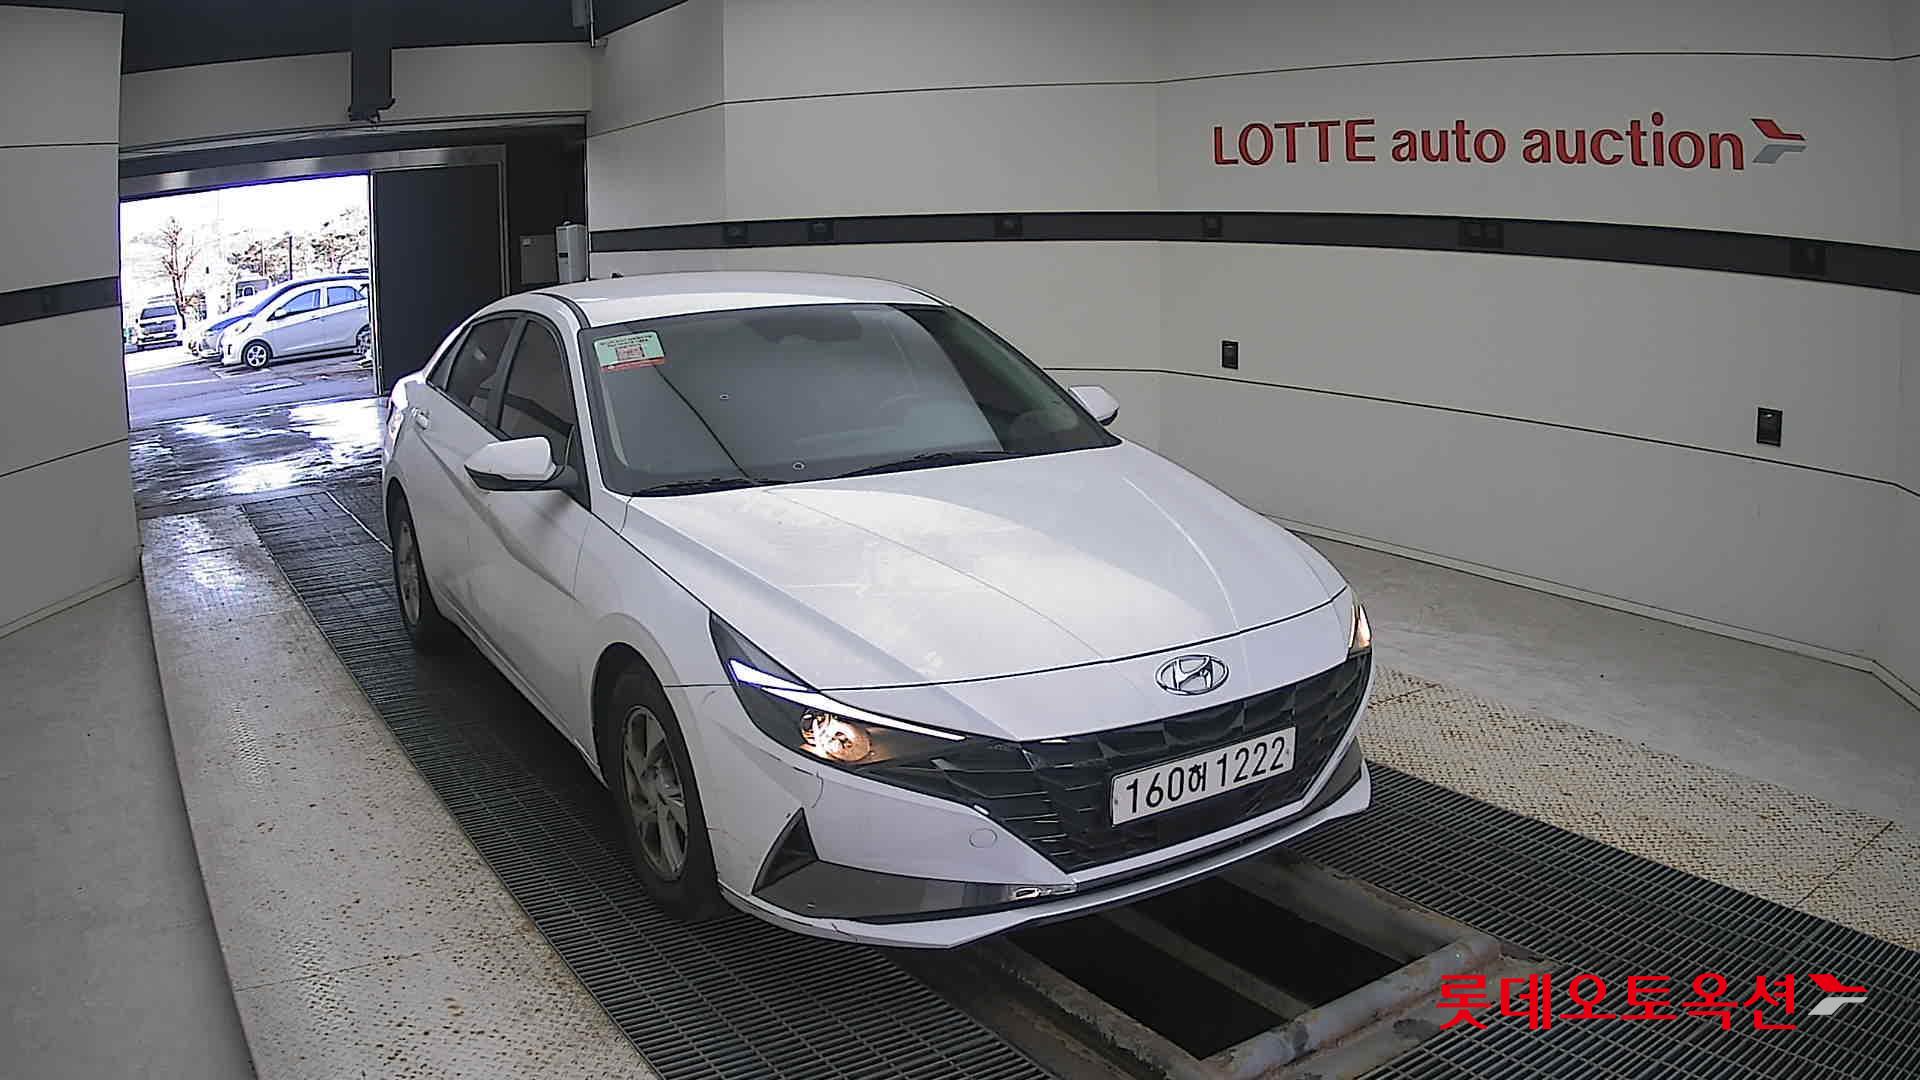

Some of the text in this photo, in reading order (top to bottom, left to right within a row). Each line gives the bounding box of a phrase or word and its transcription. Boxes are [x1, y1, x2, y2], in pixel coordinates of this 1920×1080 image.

[1213, 111, 1745, 170] LOTTE auto auction
[1216, 736, 1286, 787] 1222
